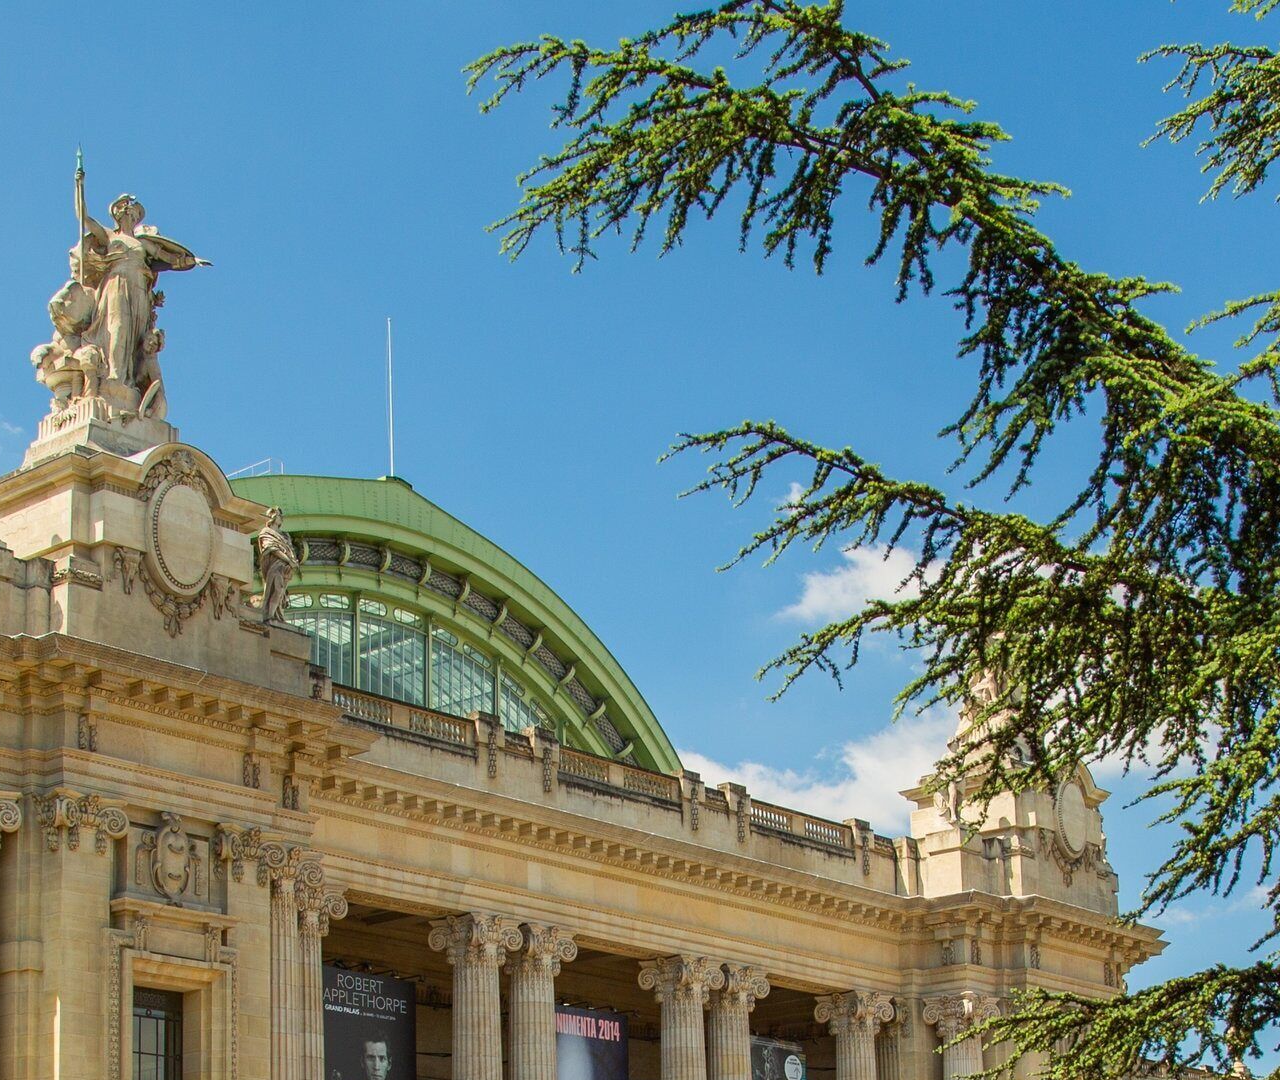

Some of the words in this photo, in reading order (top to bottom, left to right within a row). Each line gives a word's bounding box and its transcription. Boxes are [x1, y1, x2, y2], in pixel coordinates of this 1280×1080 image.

[337, 973, 384, 994] ROBERT
[323, 987, 407, 1014] APPLETHORPE
[324, 1003, 343, 1013] GRAND
[343, 1006, 360, 1016] PALAIS
[556, 1012, 597, 1038] NUMENTA
[598, 1019, 620, 1042] 2014
